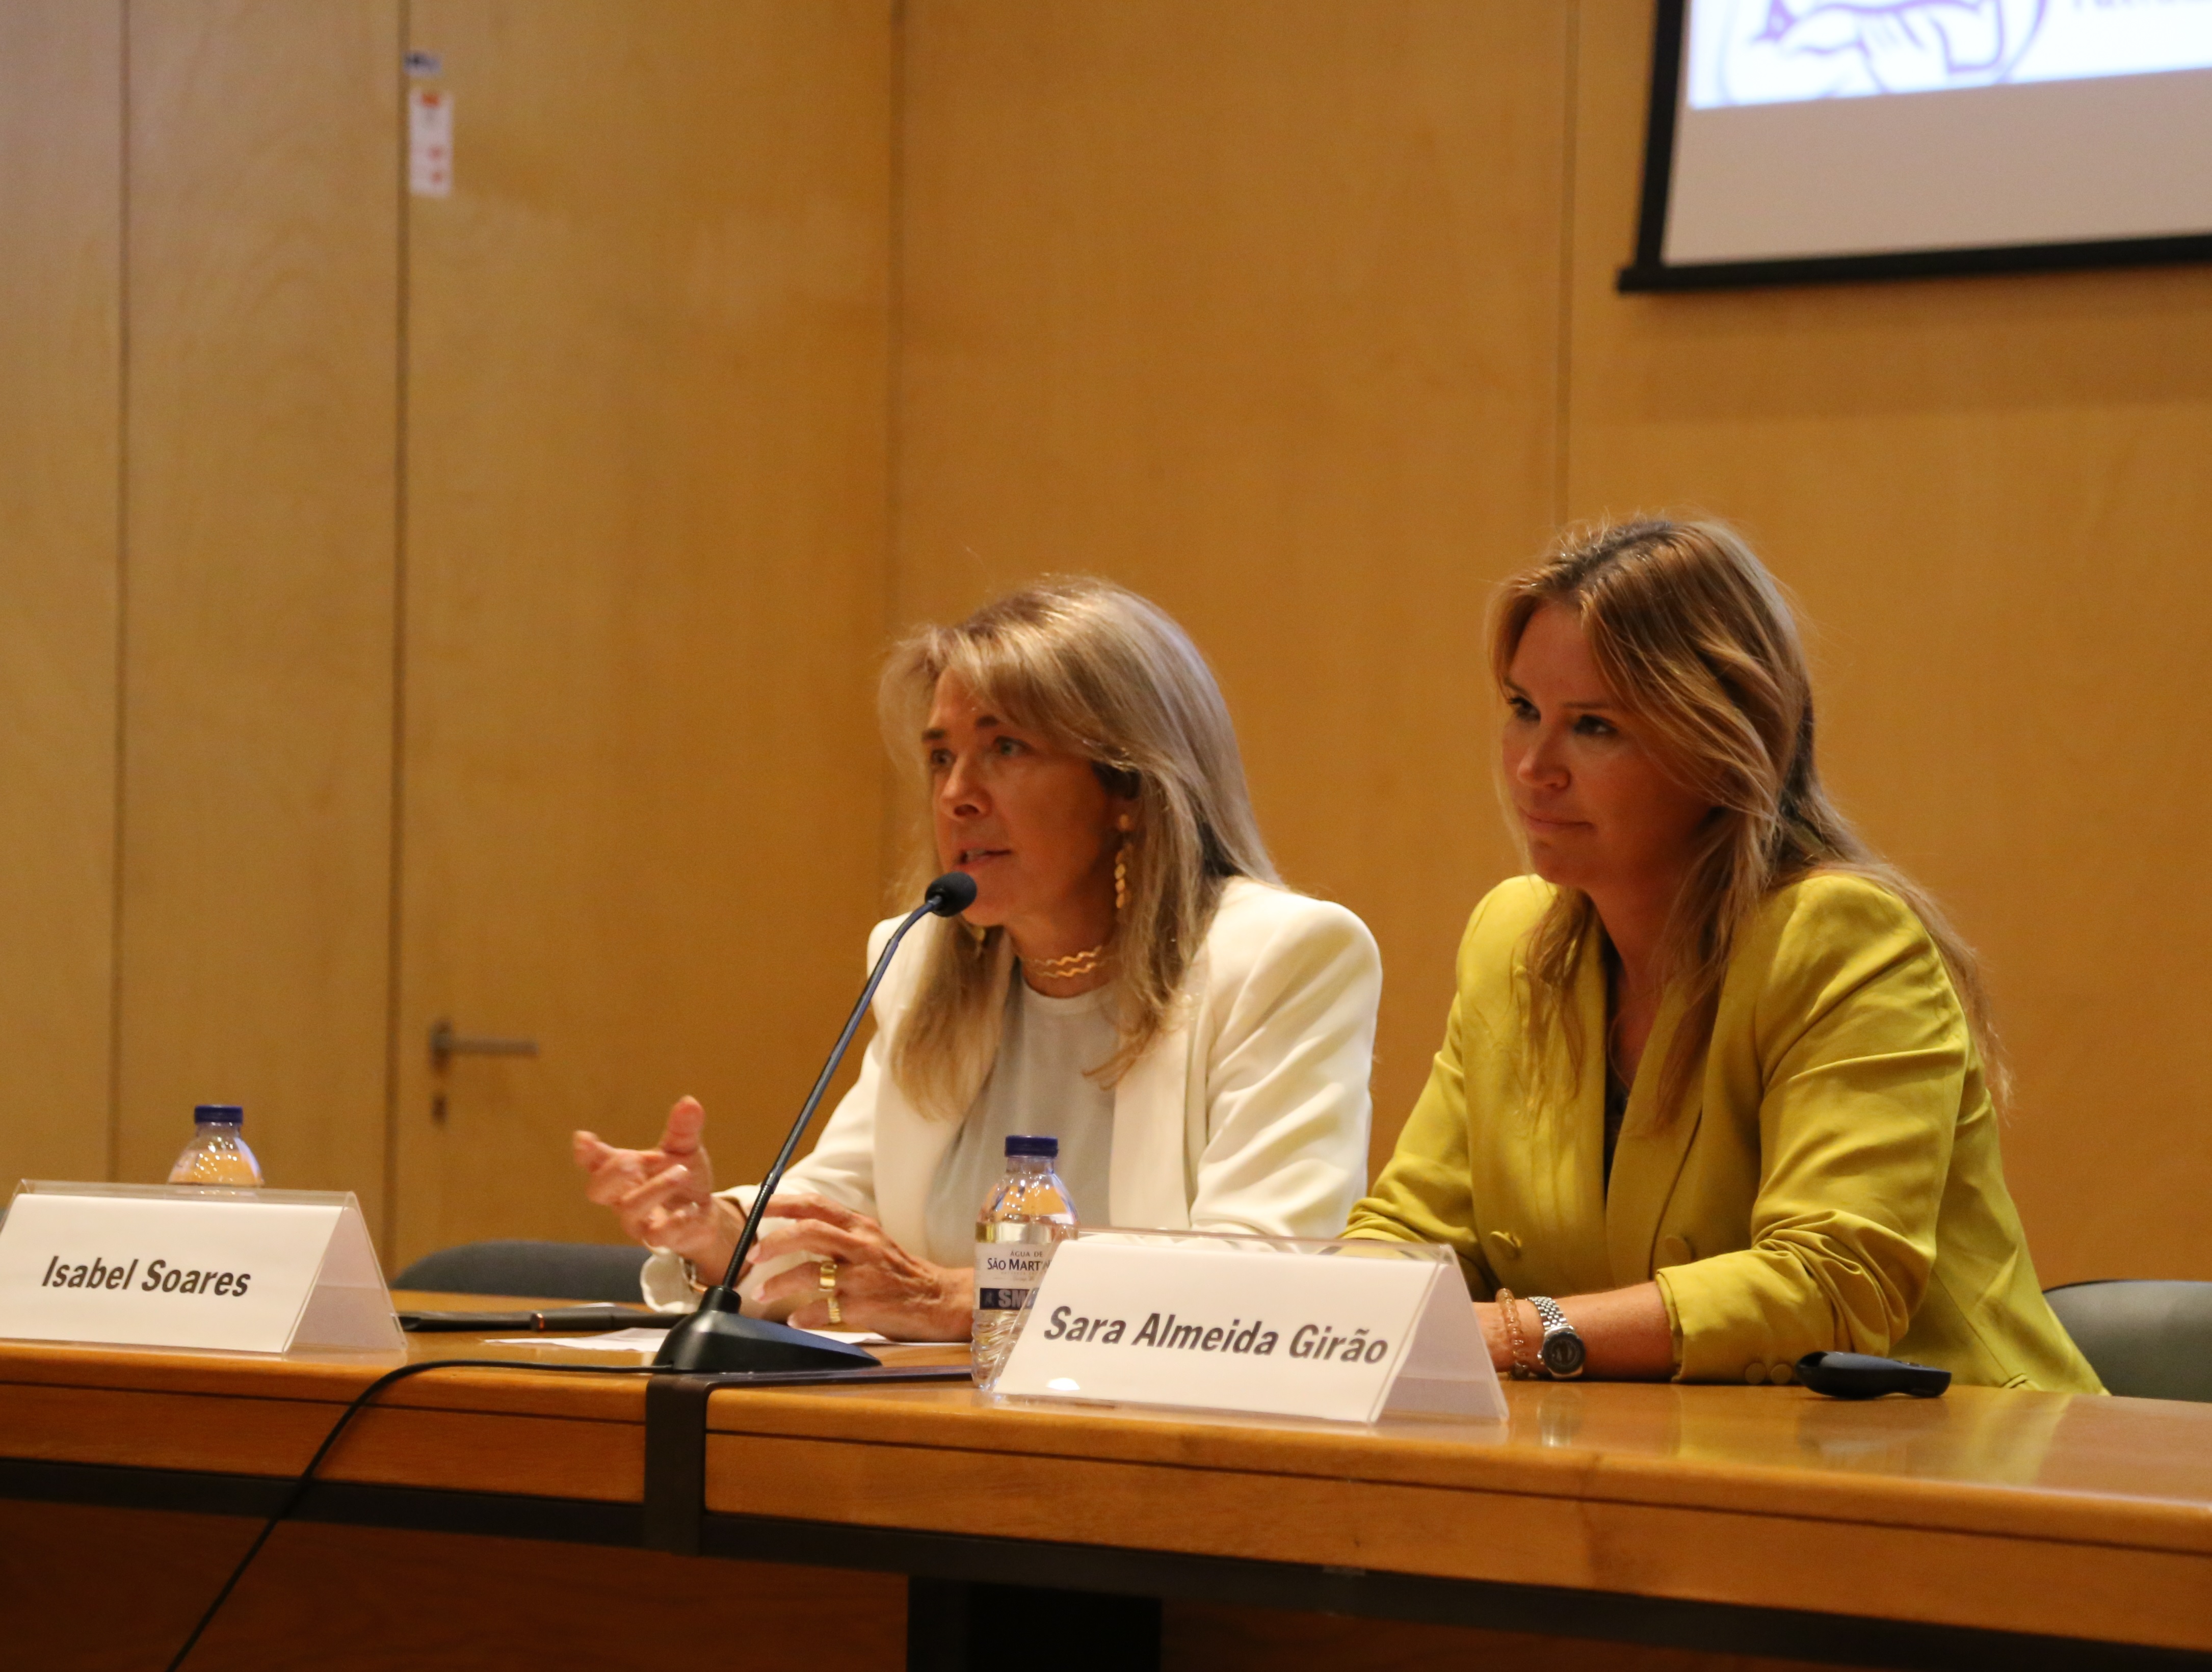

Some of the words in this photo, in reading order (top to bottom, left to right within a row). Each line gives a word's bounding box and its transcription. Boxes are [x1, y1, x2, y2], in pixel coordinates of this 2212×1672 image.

[42, 1256, 139, 1290] Isabel
[141, 1259, 251, 1297] Soares
[987, 1258, 1006, 1270] SÃO
[1044, 1306, 1126, 1343] Sara
[1132, 1313, 1279, 1355] Almeida
[1289, 1324, 1388, 1365] Girão
